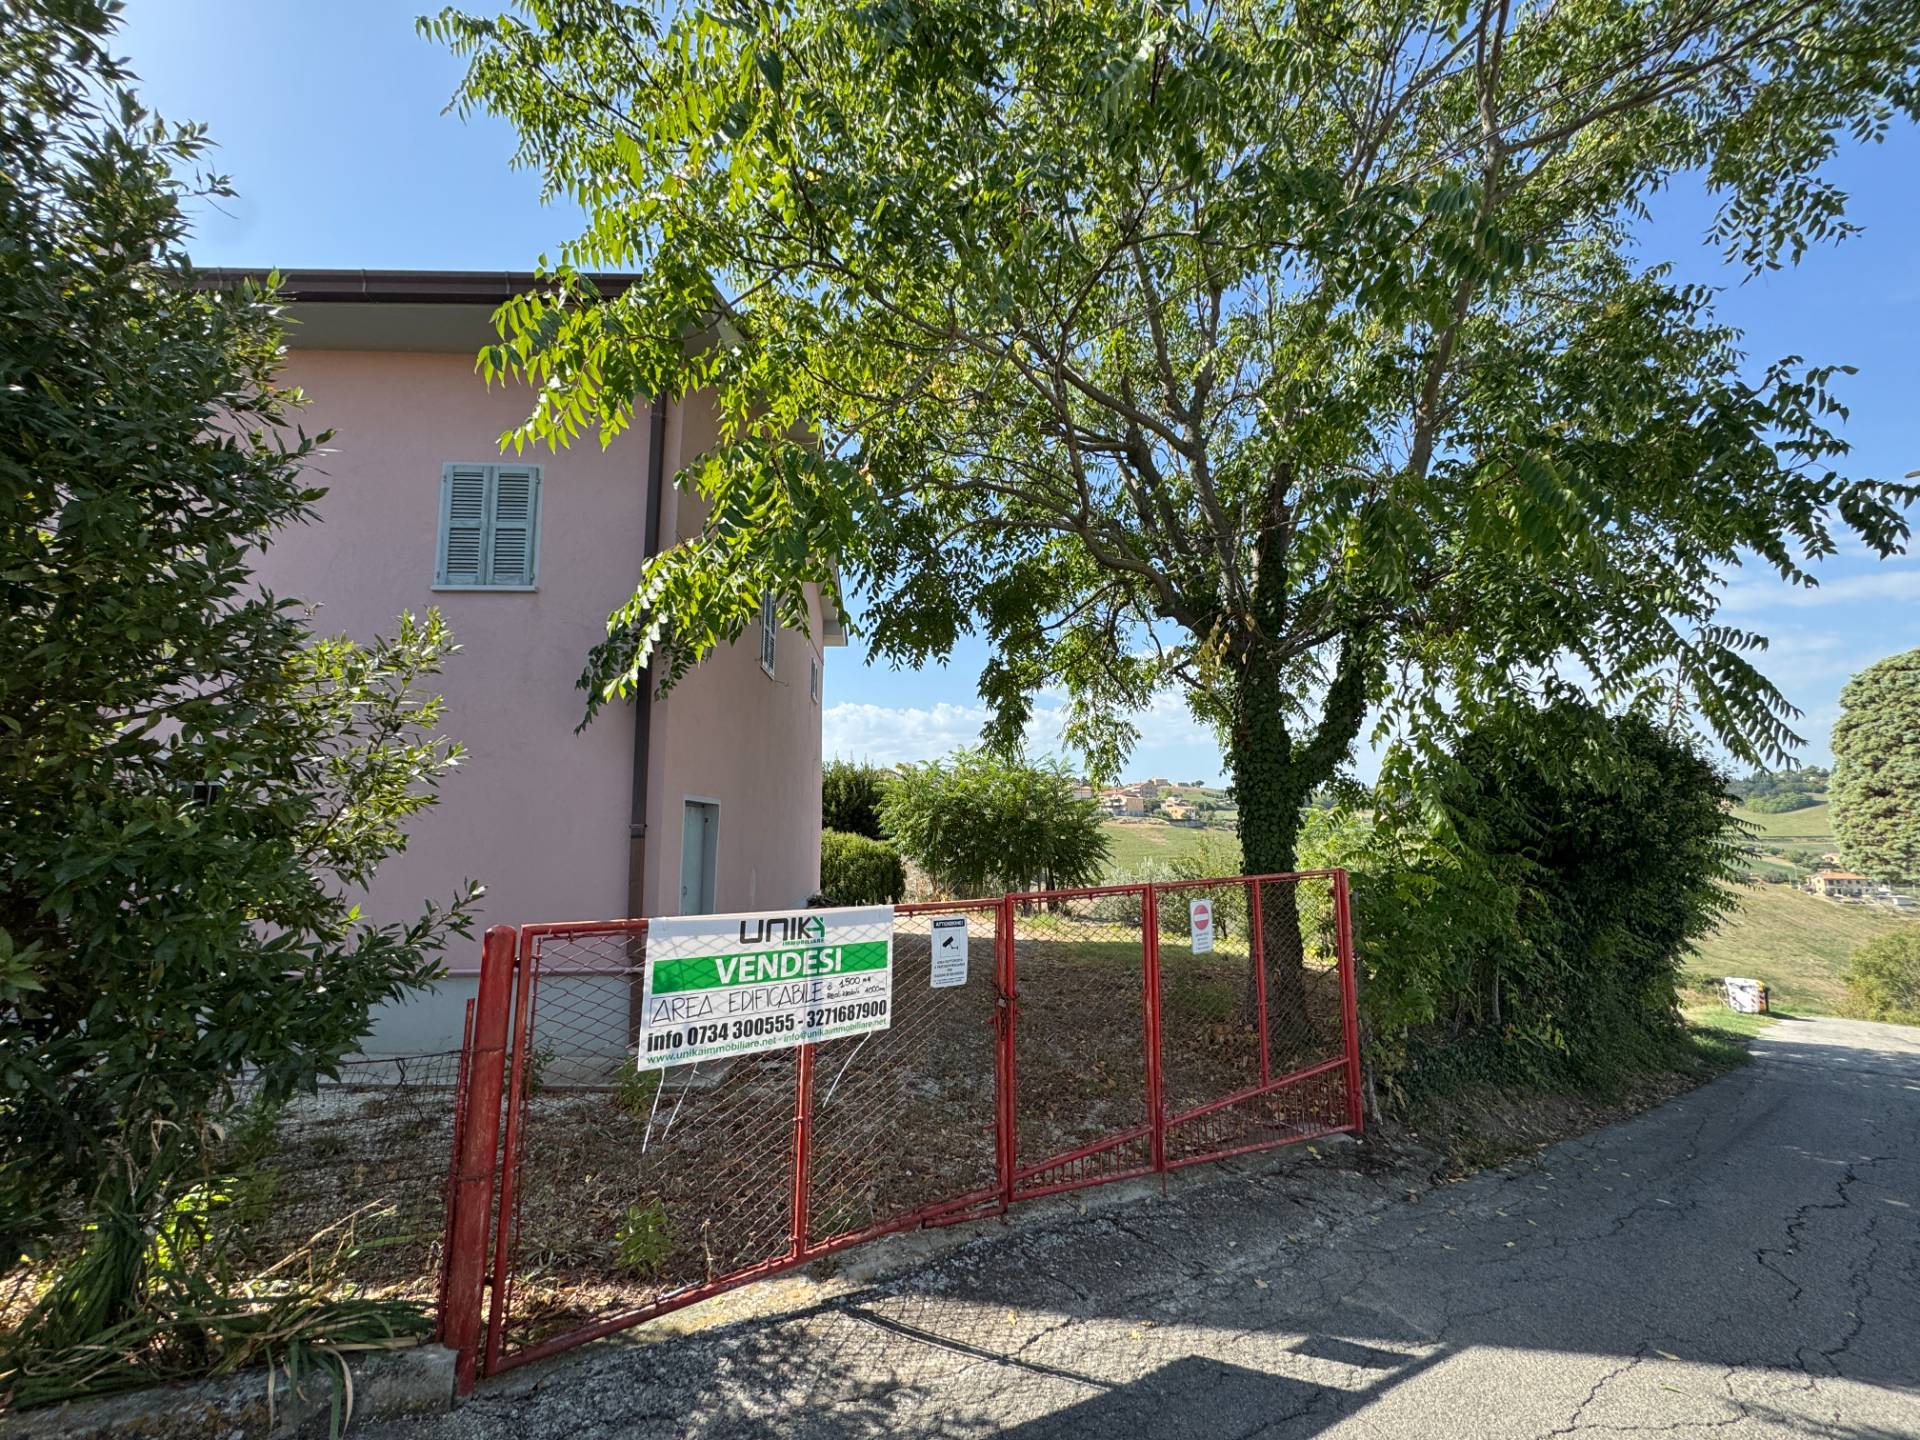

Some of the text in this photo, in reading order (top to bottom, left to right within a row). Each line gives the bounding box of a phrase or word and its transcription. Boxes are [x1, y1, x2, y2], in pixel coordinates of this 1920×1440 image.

[740, 916, 825, 944] UNIKA
[715, 948, 842, 984] VENDESI
[651, 981, 824, 1024] AREA EDIFICABILE
[647, 1030, 682, 1052] info
[687, 1022, 729, 1046] 0734
[733, 1013, 794, 1040] 300555
[807, 999, 887, 1028] 3271687900
[647, 1036, 776, 1064] www.unikaimmobiliare.net
[783, 1018, 886, 1043] info@unikaimmobiliare.net
